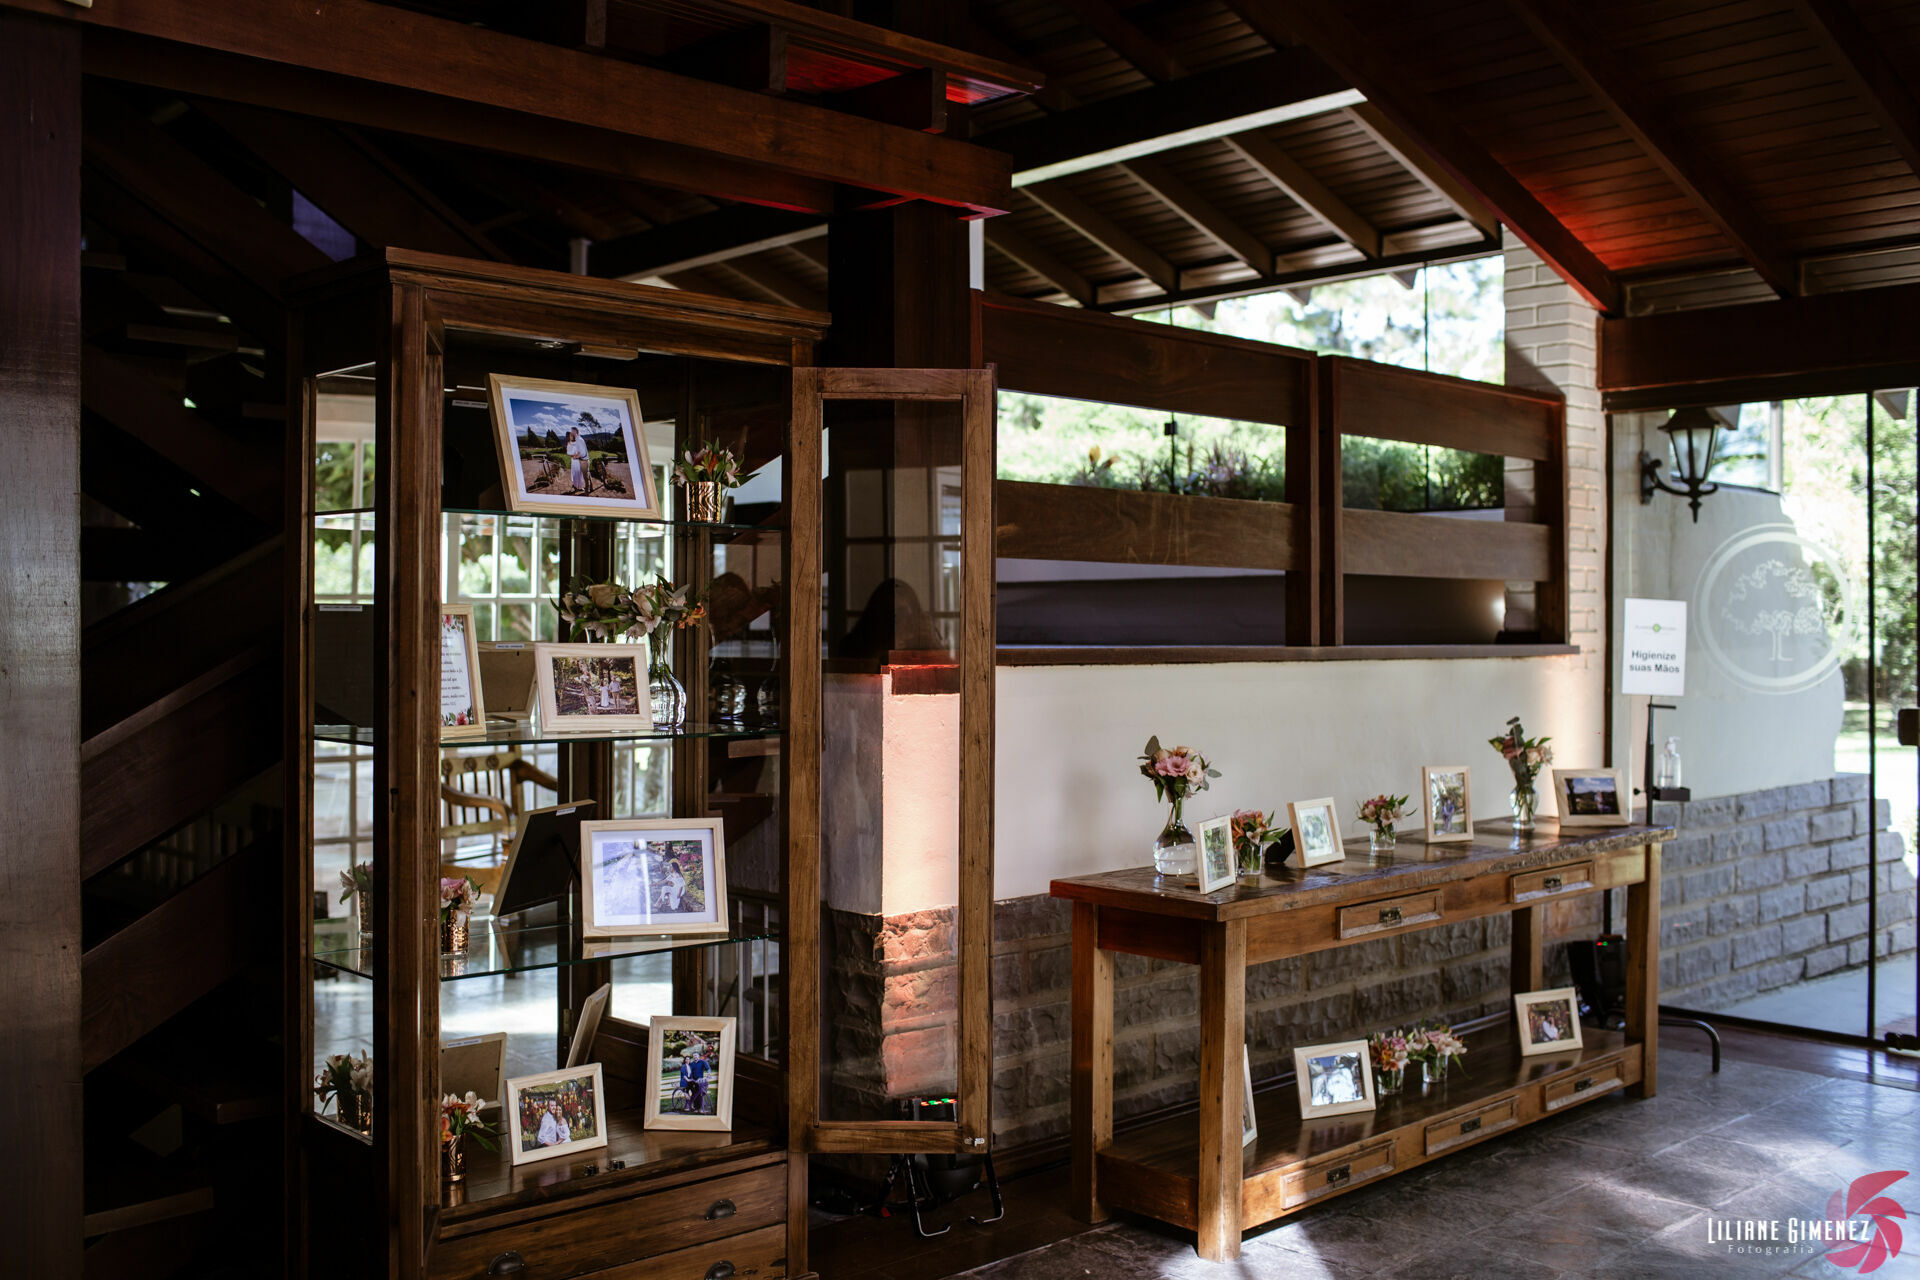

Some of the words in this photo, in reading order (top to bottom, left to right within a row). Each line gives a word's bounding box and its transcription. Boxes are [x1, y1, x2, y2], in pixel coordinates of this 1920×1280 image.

[1631, 650, 1677, 661] Higienize
[1629, 664, 1652, 672] suas
[1654, 663, 1680, 674] Mãos
